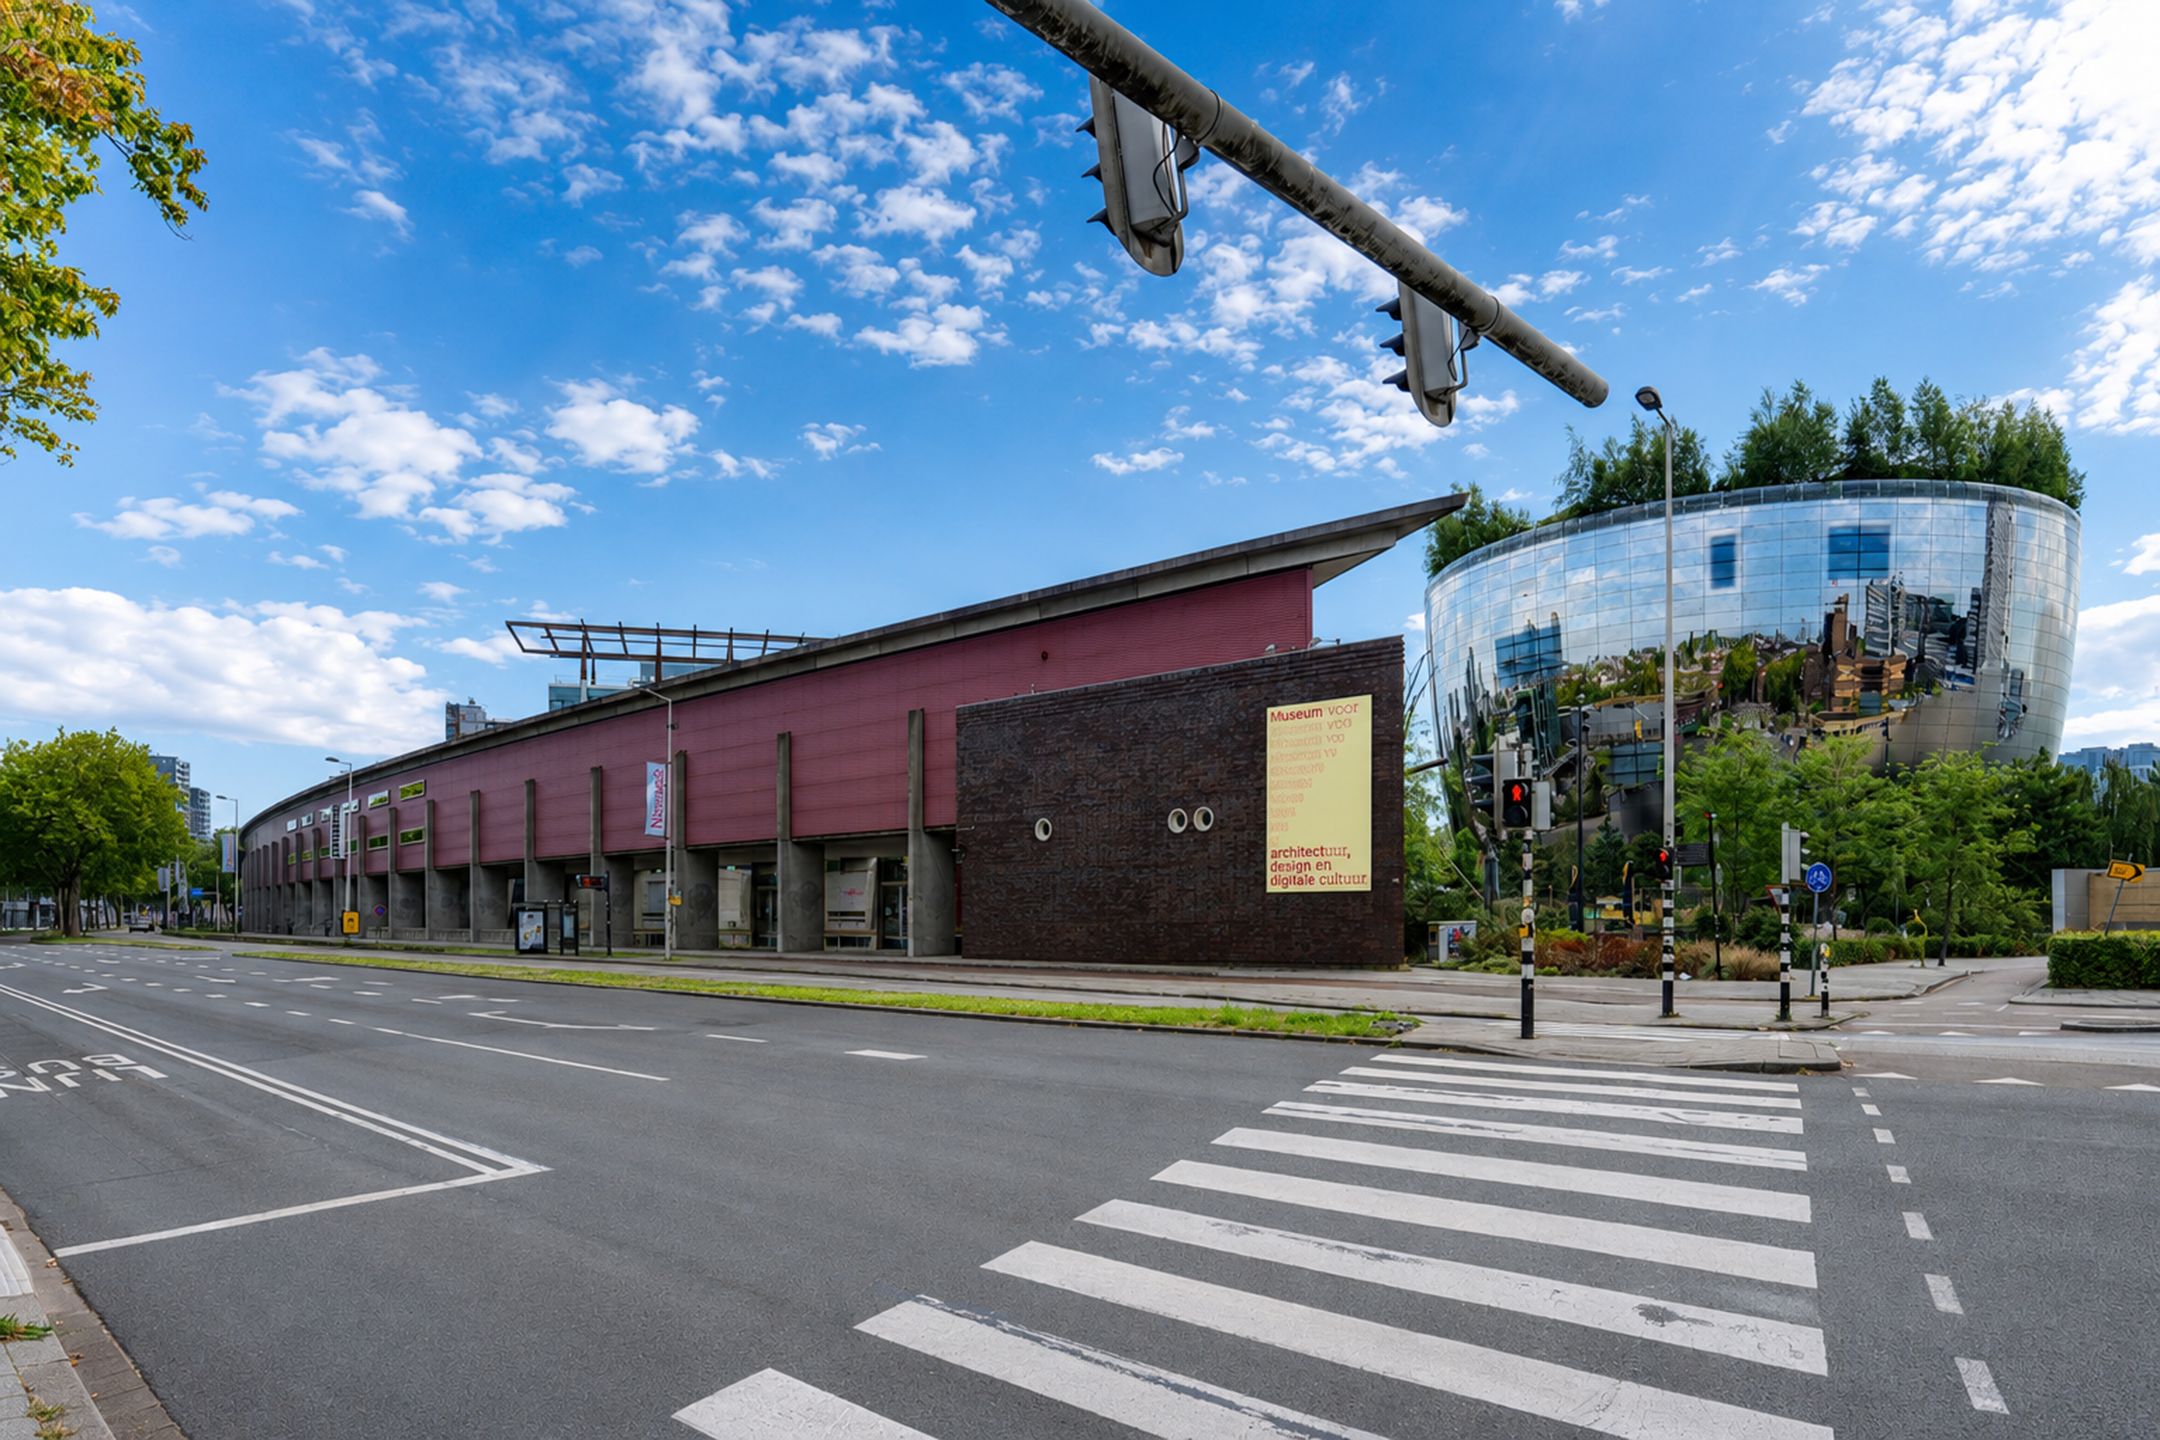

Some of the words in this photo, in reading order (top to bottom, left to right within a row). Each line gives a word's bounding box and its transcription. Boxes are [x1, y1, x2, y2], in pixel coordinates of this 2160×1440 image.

[1270, 708, 1323, 722] Museum
[1328, 704, 1358, 716] voor
[1270, 846, 1351, 860] architectuur,
[1270, 860, 1312, 874] design
[1315, 860, 1332, 871] en
[1270, 873, 1315, 889] digitale
